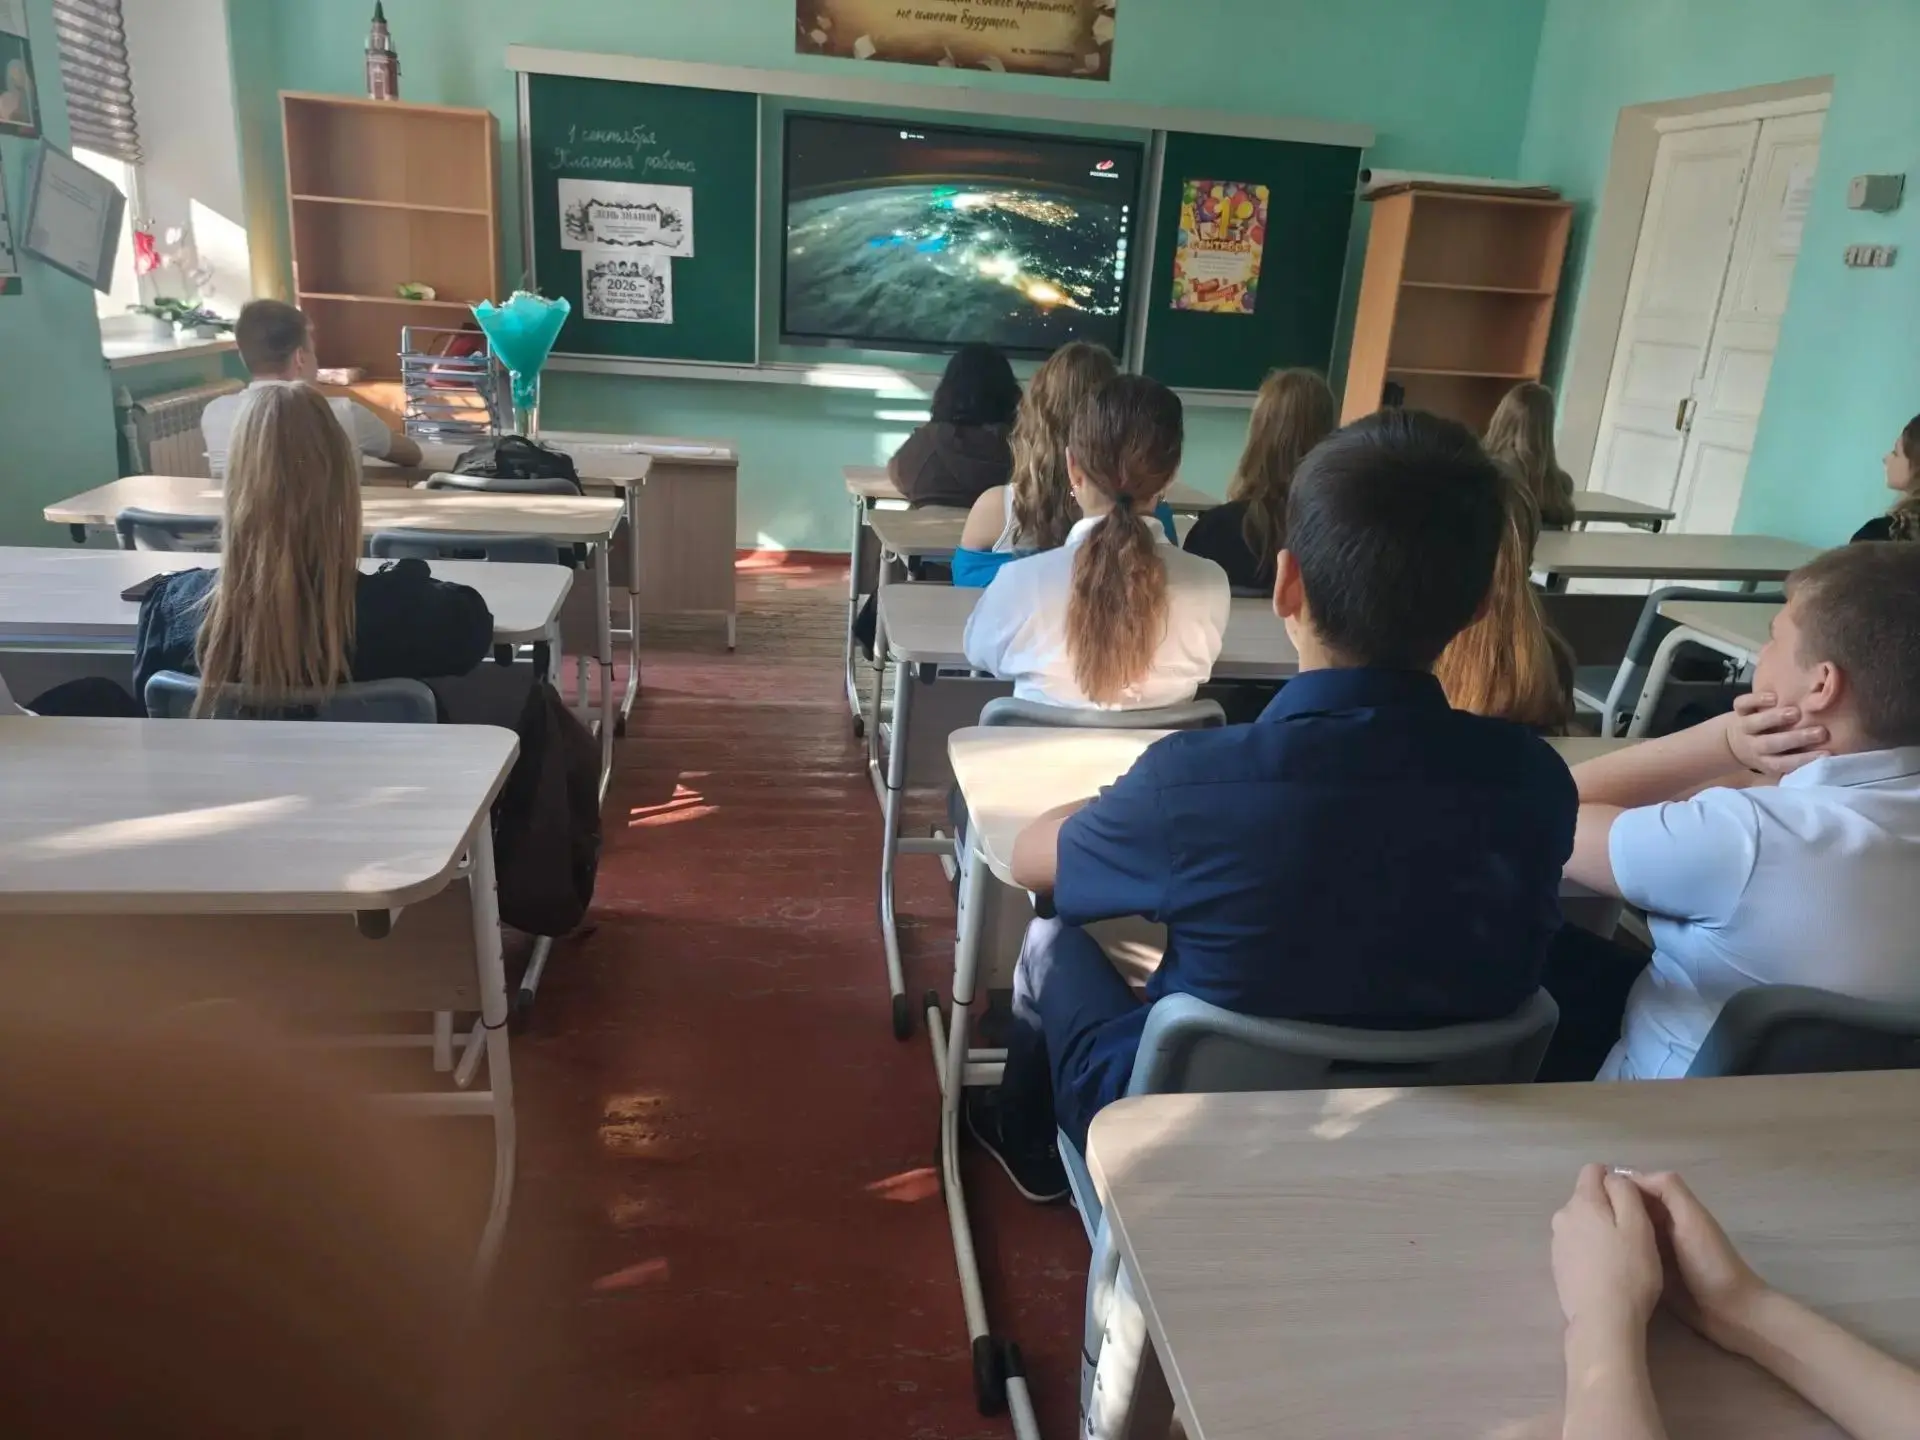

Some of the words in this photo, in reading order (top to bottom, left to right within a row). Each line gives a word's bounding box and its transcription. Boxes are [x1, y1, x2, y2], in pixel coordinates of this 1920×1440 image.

[896, 8, 911, 19] не
[915, 10, 958, 24] имеет
[568, 123, 577, 144] 1
[582, 124, 657, 152] сентября
[641, 149, 696, 176] работа
